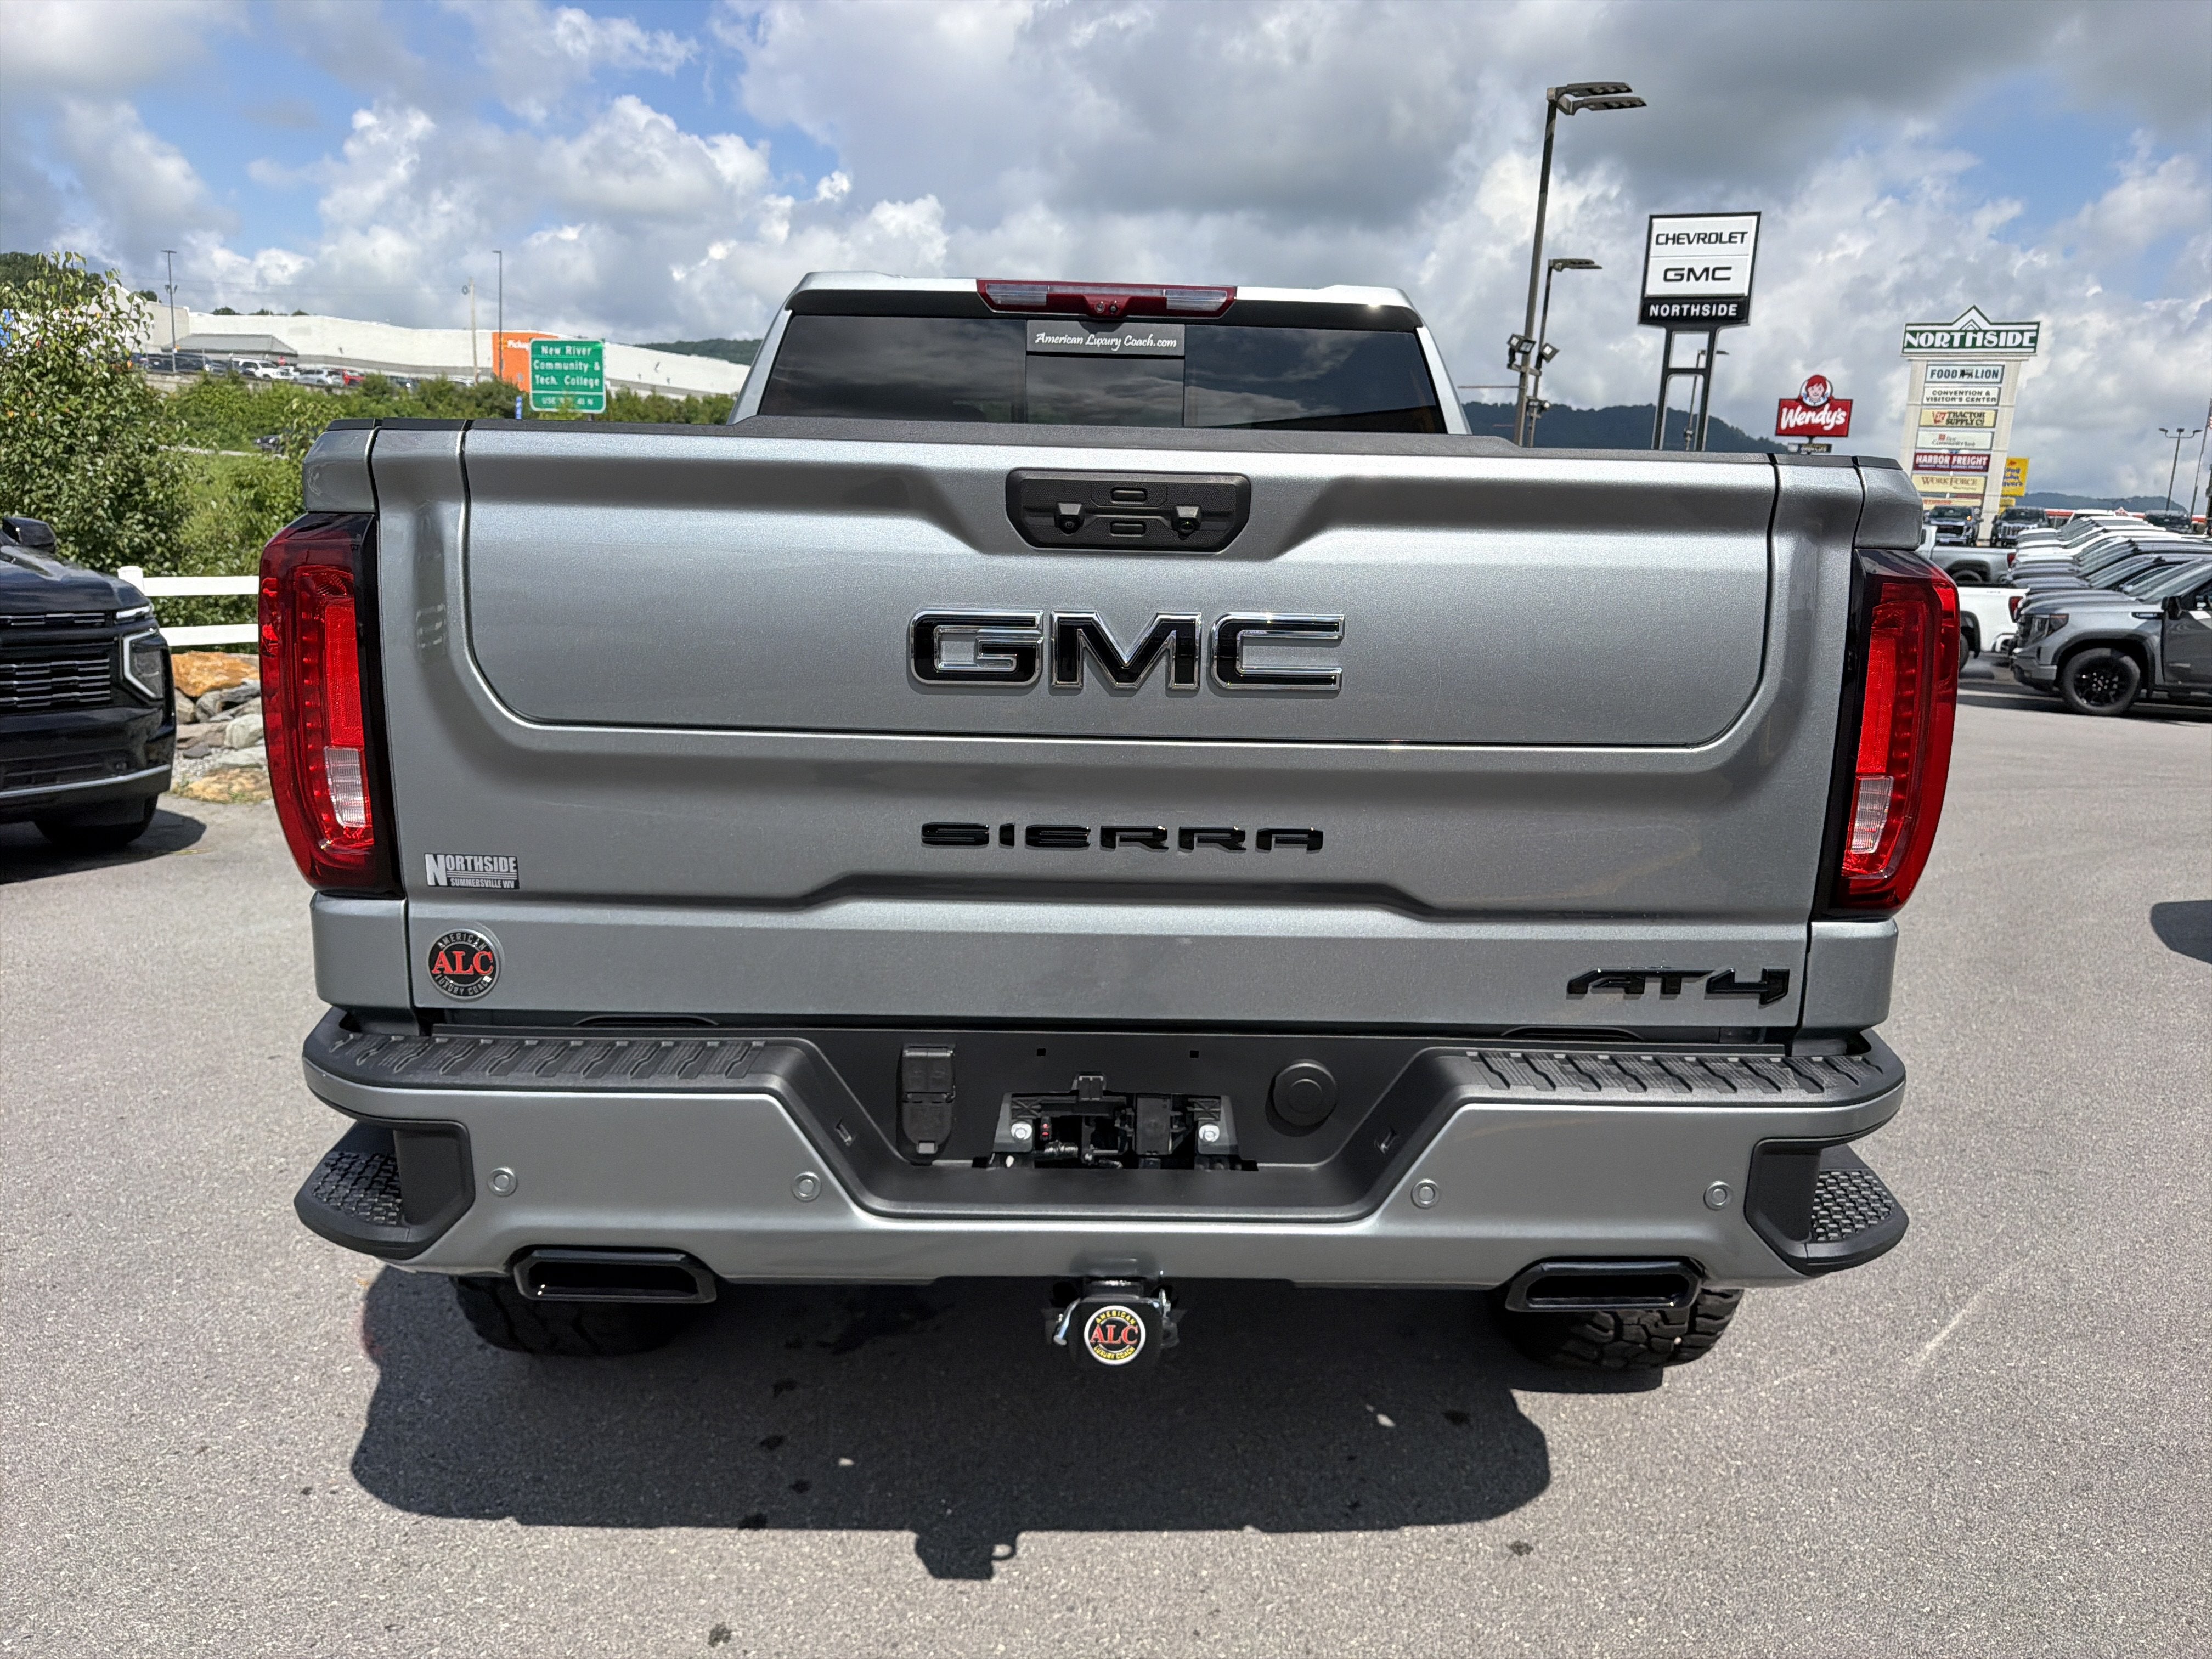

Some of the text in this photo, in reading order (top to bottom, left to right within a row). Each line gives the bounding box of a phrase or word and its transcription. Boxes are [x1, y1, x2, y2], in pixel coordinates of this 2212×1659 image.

[1655, 231, 1748, 245] CHEVROLET
[1663, 267, 1732, 282] GMC
[1649, 304, 1738, 317] NORTHSIDE
[1035, 332, 1177, 352] American Luxury Coach.com
[1904, 331, 2036, 348] NORTHSIDE
[541, 345, 592, 356] New River
[533, 359, 601, 373] Community &
[1930, 369, 1999, 379] FOOD LION
[534, 374, 600, 388] Tech. College
[1780, 403, 1847, 431] Wendy's
[1915, 454, 1988, 466] HARBOR FREIGHT
[910, 609, 1345, 691] GMC
[922, 822, 1323, 851] SIERRA
[425, 853, 517, 887] NORTHSIDE
[450, 878, 515, 889] SUMMERSVILLE WV
[437, 932, 487, 951] AMERICAN
[431, 950, 494, 975] ALC
[468, 975, 492, 995] COAC
[1567, 967, 1790, 1005] AT4
[1096, 1310, 1137, 1325] AMERICAN
[1090, 1324, 1139, 1344] ALC
